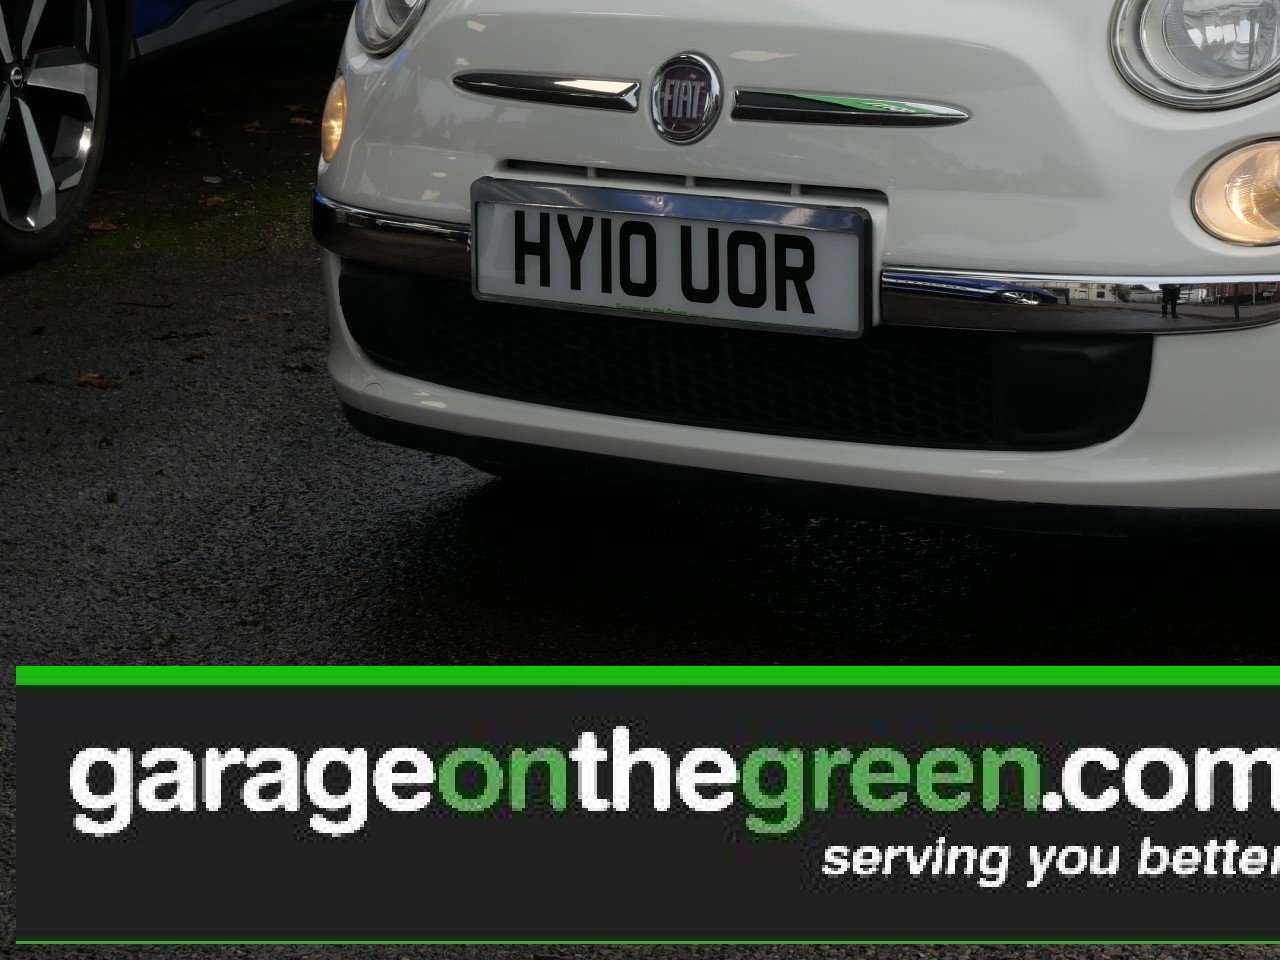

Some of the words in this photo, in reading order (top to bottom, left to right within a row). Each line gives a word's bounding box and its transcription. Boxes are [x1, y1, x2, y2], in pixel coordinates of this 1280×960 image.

[661, 79, 706, 119] FIAT
[514, 210, 657, 298] HY10
[680, 224, 815, 314] UOR
